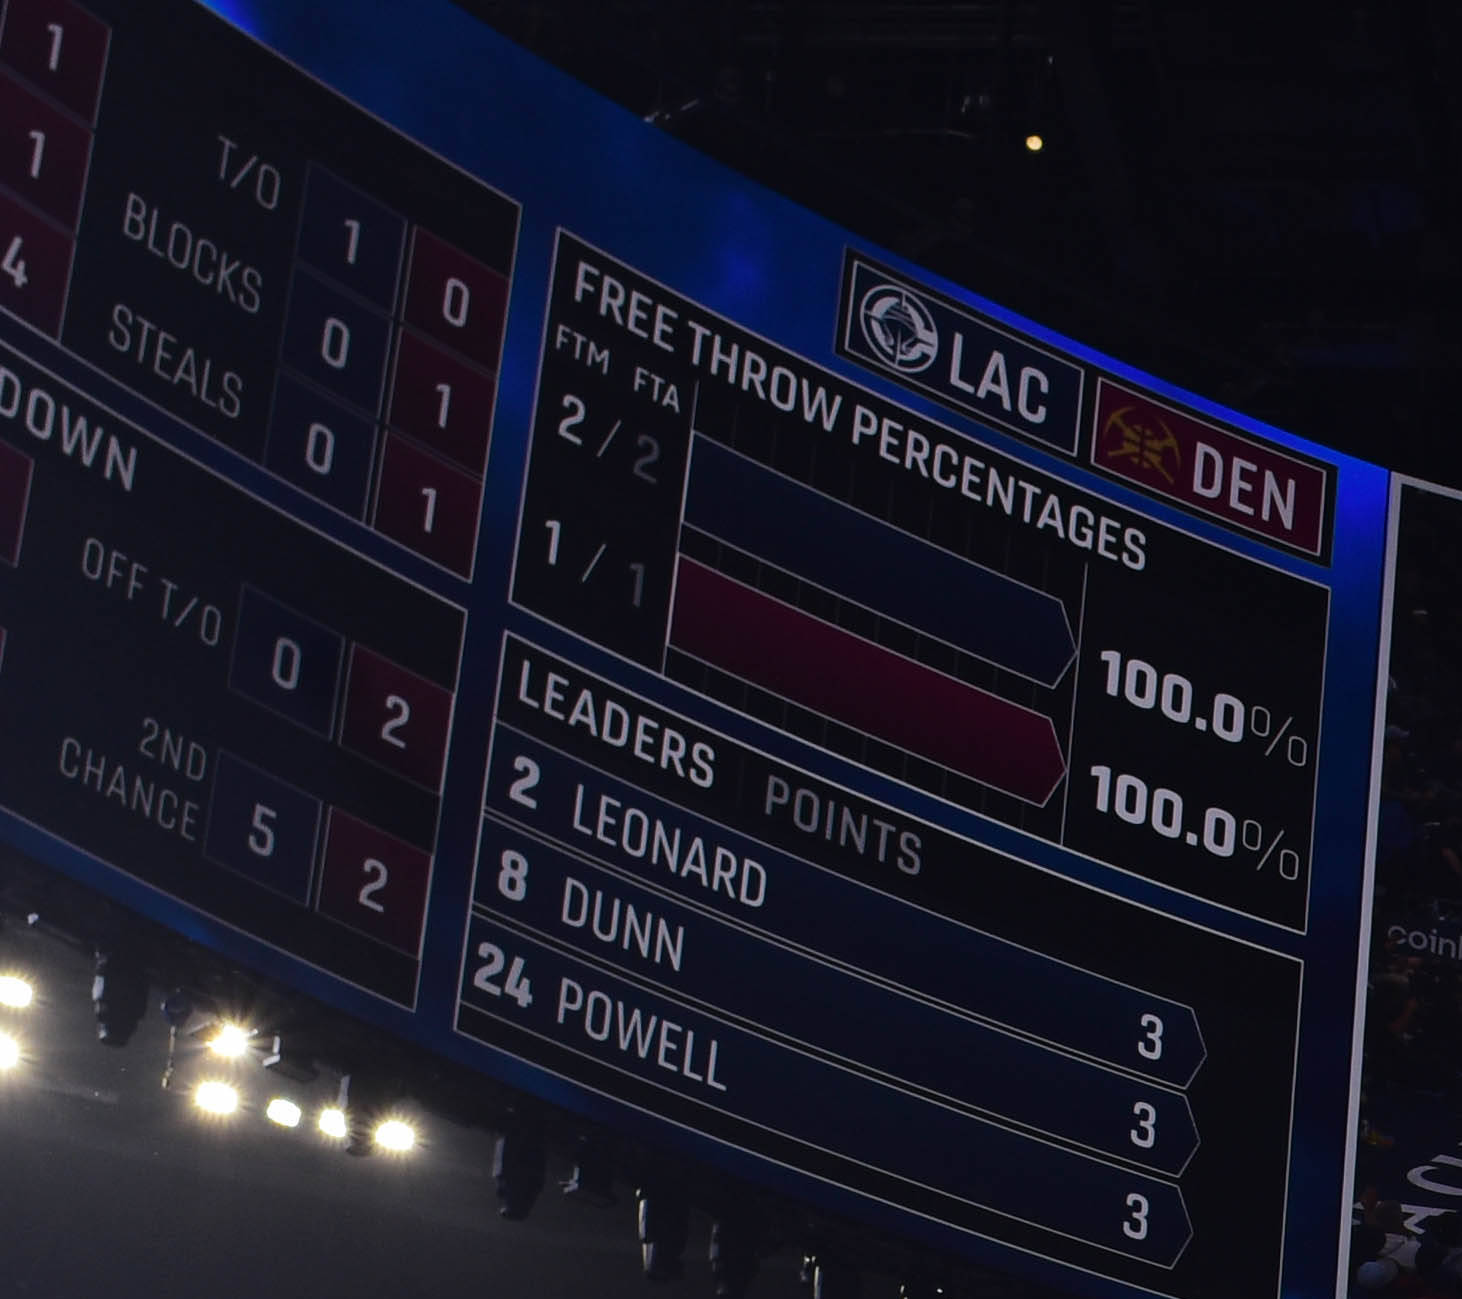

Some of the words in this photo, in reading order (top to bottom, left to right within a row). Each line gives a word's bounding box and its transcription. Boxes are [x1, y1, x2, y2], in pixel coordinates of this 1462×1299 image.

[48, 24, 62, 71] 1
[29, 130, 44, 178] 1
[2, 237, 28, 287] 4
[344, 219, 358, 263] 1
[124, 192, 264, 314] BLOCKS
[436, 384, 450, 428] 1
[109, 304, 243, 419] STEALS
[422, 488, 436, 532] 1
[556, 324, 611, 377] FTM
[633, 367, 682, 414] FTA
[573, 260, 678, 353] FREE
[688, 321, 843, 432] THROW
[851, 403, 1147, 572] PERCENTAGES
[950, 332, 1049, 427] LAC
[1192, 442, 1296, 531] DEN
[81, 538, 148, 600] OFF
[382, 695, 411, 749] 2
[139, 717, 207, 782] 2ND
[1100, 651, 1307, 767] 100.0%
[58, 737, 198, 842] CHANCE
[248, 803, 277, 857] 5
[359, 858, 388, 912] 2
[518, 661, 714, 789] LEADERS
[766, 775, 922, 876] POINTS
[1089, 767, 1300, 881] 100.0%
[510, 757, 538, 809] 2
[572, 783, 767, 909] LEONARD
[1138, 1015, 1162, 1060] 3
[497, 850, 527, 903] 8
[562, 877, 685, 972] DUNN
[1131, 1102, 1155, 1149] 3
[474, 942, 532, 1009] 24
[557, 978, 728, 1092] POWELL
[1123, 1194, 1148, 1240] 3
